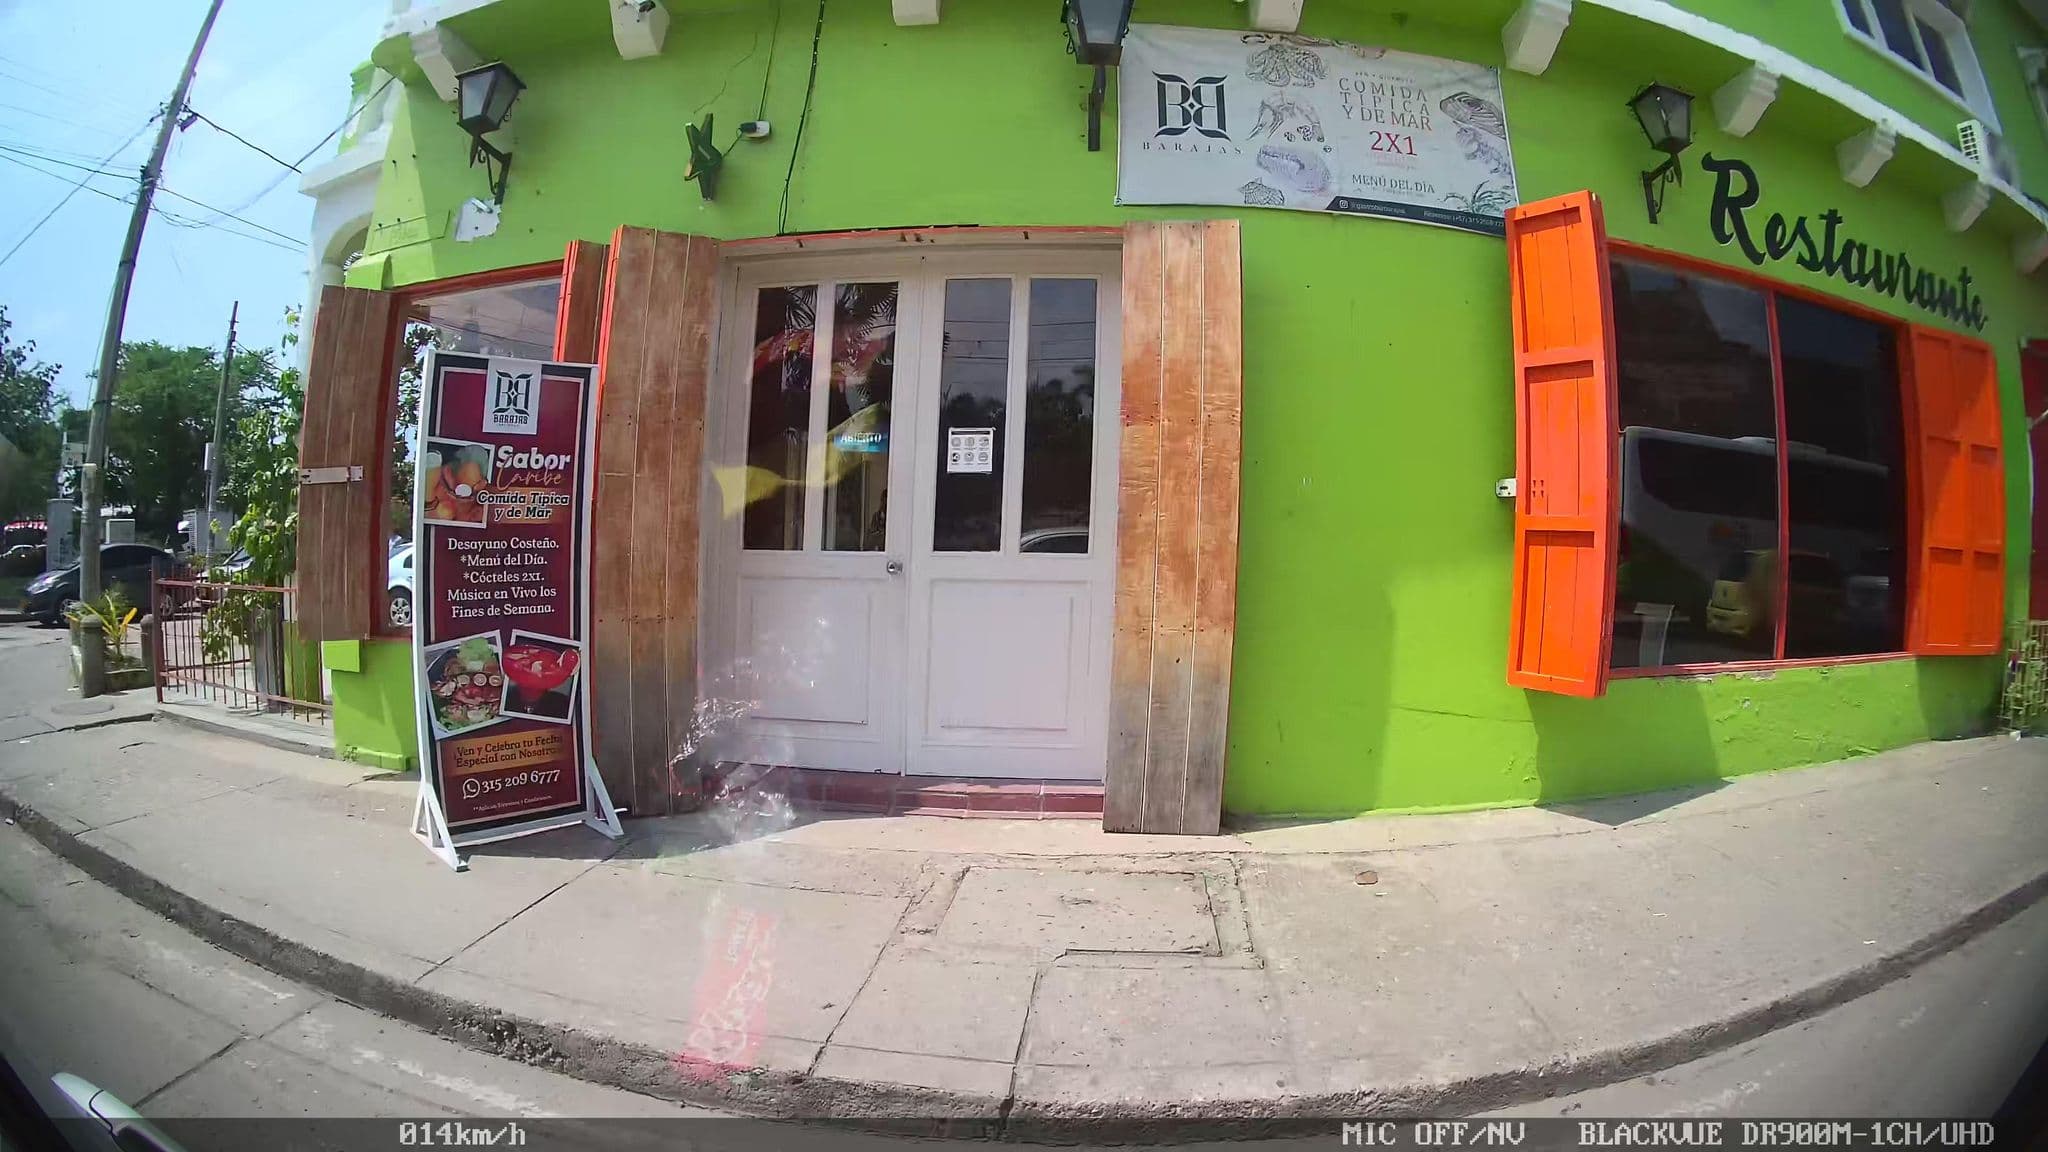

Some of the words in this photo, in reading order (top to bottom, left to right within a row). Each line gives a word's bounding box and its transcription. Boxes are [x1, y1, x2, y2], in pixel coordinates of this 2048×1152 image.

[1339, 77, 1428, 102] COMIDA
[1342, 104, 1353, 120] Y
[1360, 106, 1385, 123] DE
[1390, 111, 1433, 131] MAR
[1143, 141, 1241, 154] BARAJAS
[1369, 130, 1418, 156] 2X1
[1352, 173, 1387, 187] MENÚ
[1389, 178, 1413, 191] DEL
[1701, 152, 1989, 333] Restaurante
[493, 414, 528, 425] BARAJAS
[496, 445, 571, 470] Sabor
[496, 460, 562, 491] Caribe
[477, 490, 527, 505] Comida
[495, 508, 506, 521] y
[506, 506, 522, 519] de
[525, 505, 552, 519] Mar
[448, 537, 508, 552] Desayuno
[510, 537, 559, 549] Costeño.
[503, 553, 521, 565] del
[524, 553, 548, 565] Día.
[447, 588, 491, 601] Música
[494, 590, 508, 599] en
[510, 586, 537, 598] Vivo
[540, 586, 557, 597] los
[451, 605, 485, 618] Fines
[487, 605, 500, 616] de
[503, 603, 555, 616] Semana.
[456, 746, 475, 757] Ven
[477, 746, 483, 756] y
[484, 740, 521, 753] Celebra
[523, 739, 533, 748] tu
[456, 755, 499, 768] Especial
[500, 752, 517, 762] con
[481, 778, 502, 794] 315
[504, 772, 528, 788] 209
[530, 769, 561, 785] 6777
